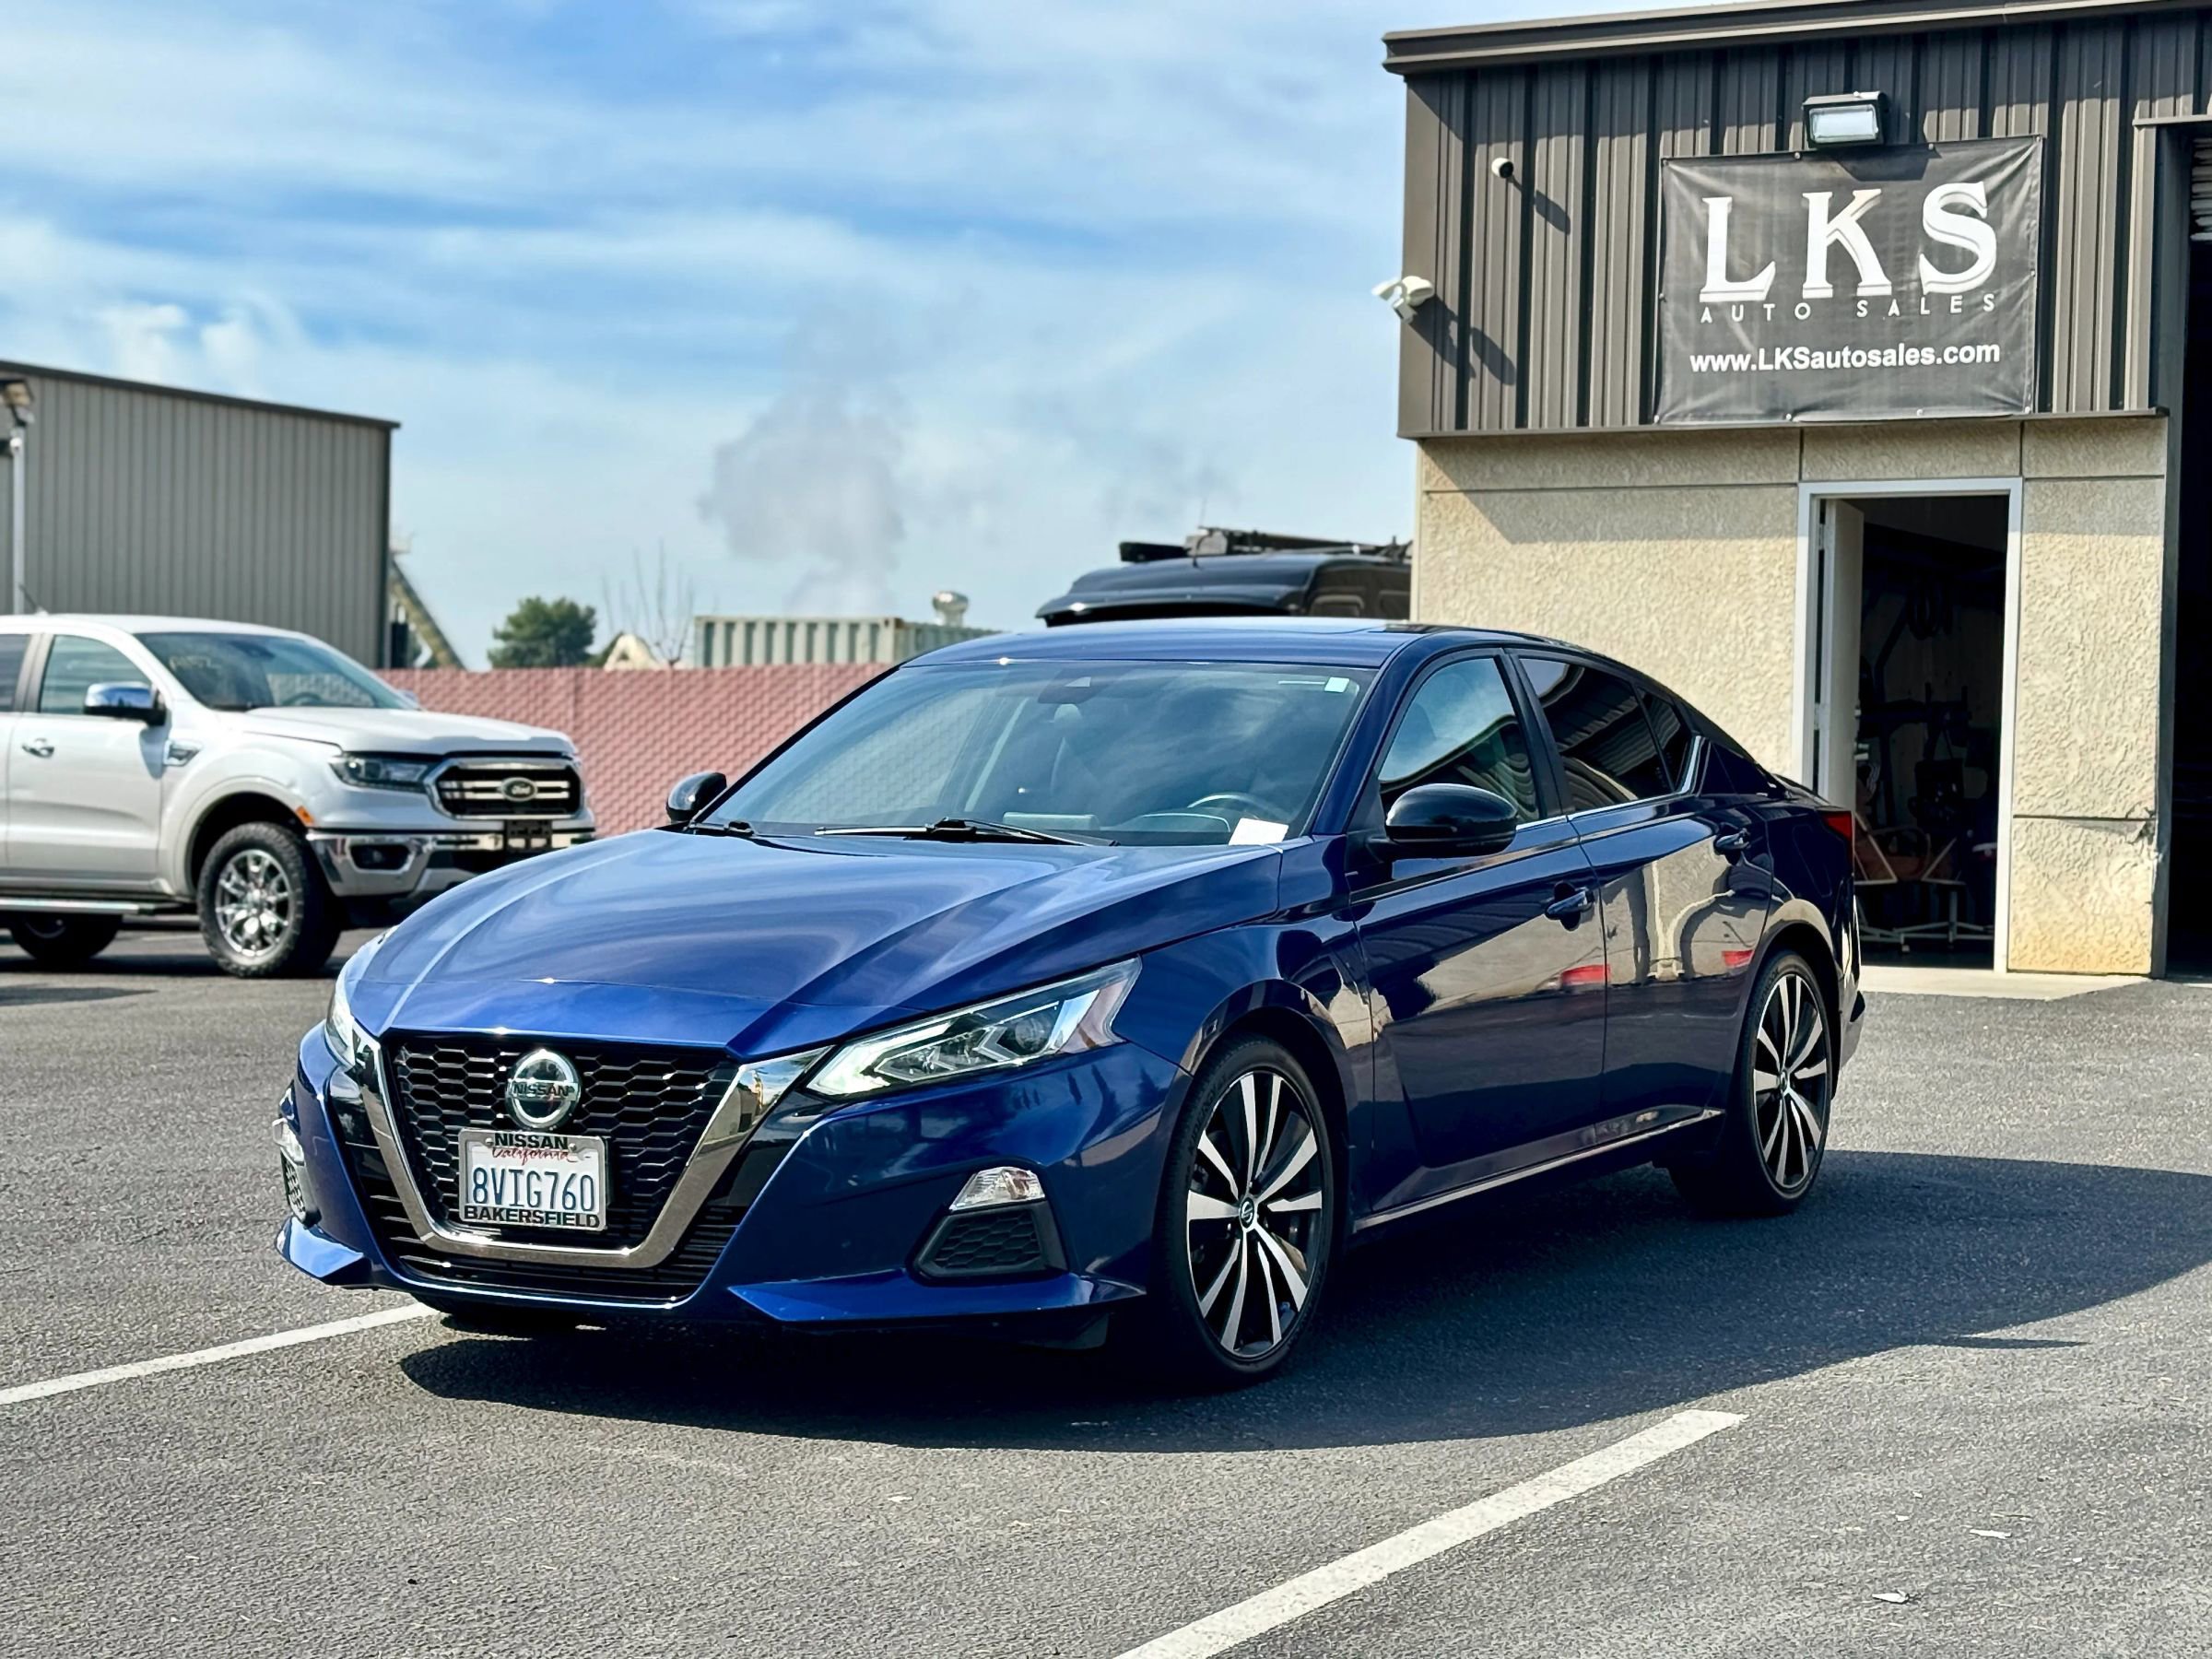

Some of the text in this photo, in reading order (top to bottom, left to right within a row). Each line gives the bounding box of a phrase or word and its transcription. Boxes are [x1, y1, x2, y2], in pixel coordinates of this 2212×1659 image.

[1700, 181, 1997, 302] LKS
[1700, 293, 1997, 324] AUTO SALES
[1689, 342, 2001, 373] www.LKSautosales.com
[512, 1082, 570, 1097] NISSAN
[494, 1133, 569, 1150] NISSAN
[472, 1166, 595, 1213] 8VIG760
[464, 1205, 600, 1229] BAKERSFIELD
